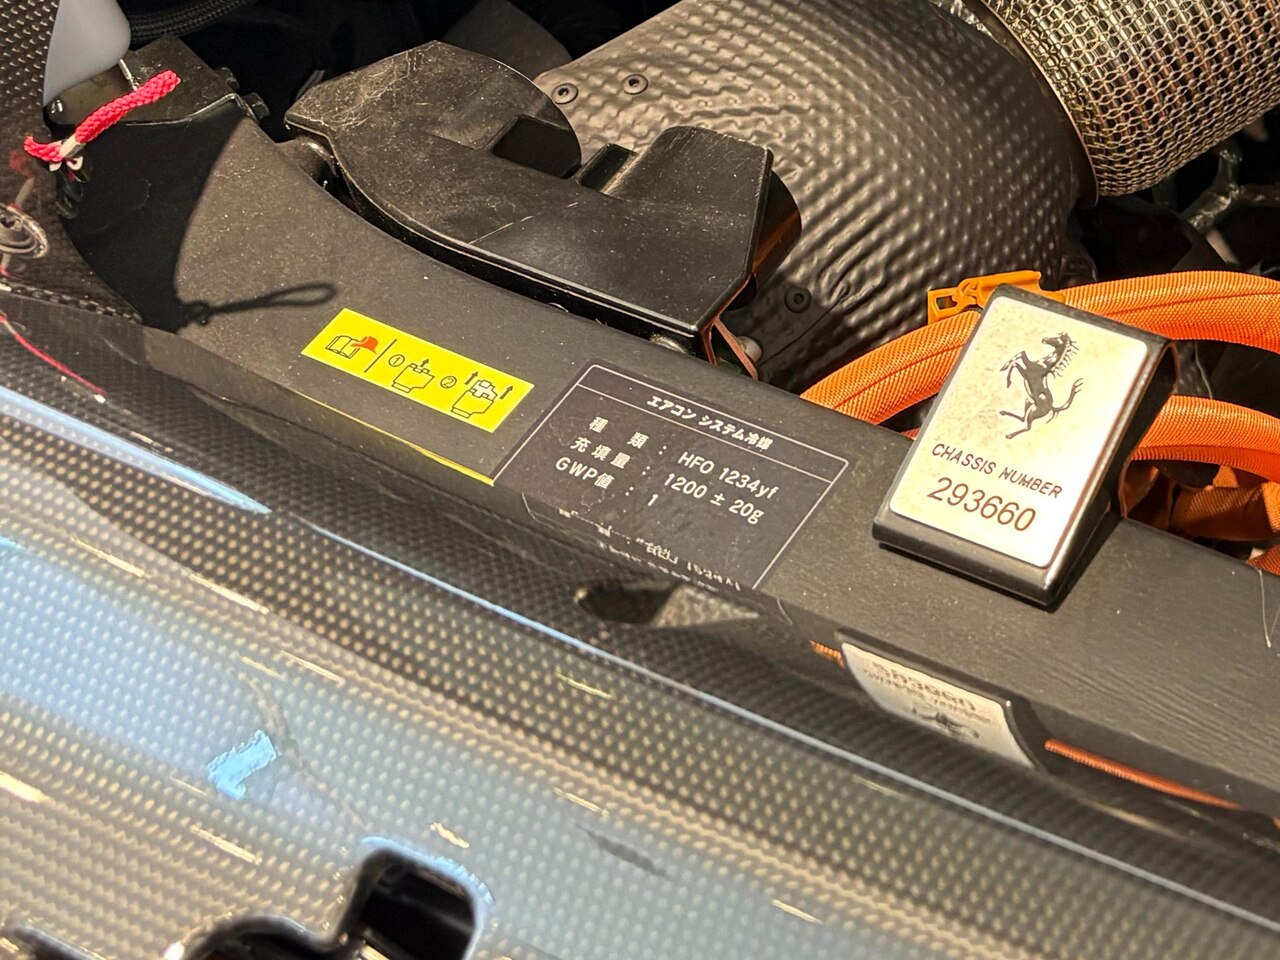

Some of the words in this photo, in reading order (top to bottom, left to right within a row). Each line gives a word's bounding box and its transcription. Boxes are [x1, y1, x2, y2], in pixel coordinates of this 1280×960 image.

[646, 395, 697, 420] エアコン
[698, 415, 774, 452] システム冷媒
[677, 451, 716, 475] HFO
[718, 467, 780, 500] 1234yf
[931, 442, 998, 476] CHASSIS
[998, 467, 1064, 500] NUMBER
[646, 492, 660, 507] 1
[663, 473, 708, 500] 1200
[728, 499, 766, 526] 20g
[927, 476, 1037, 533] 293660
